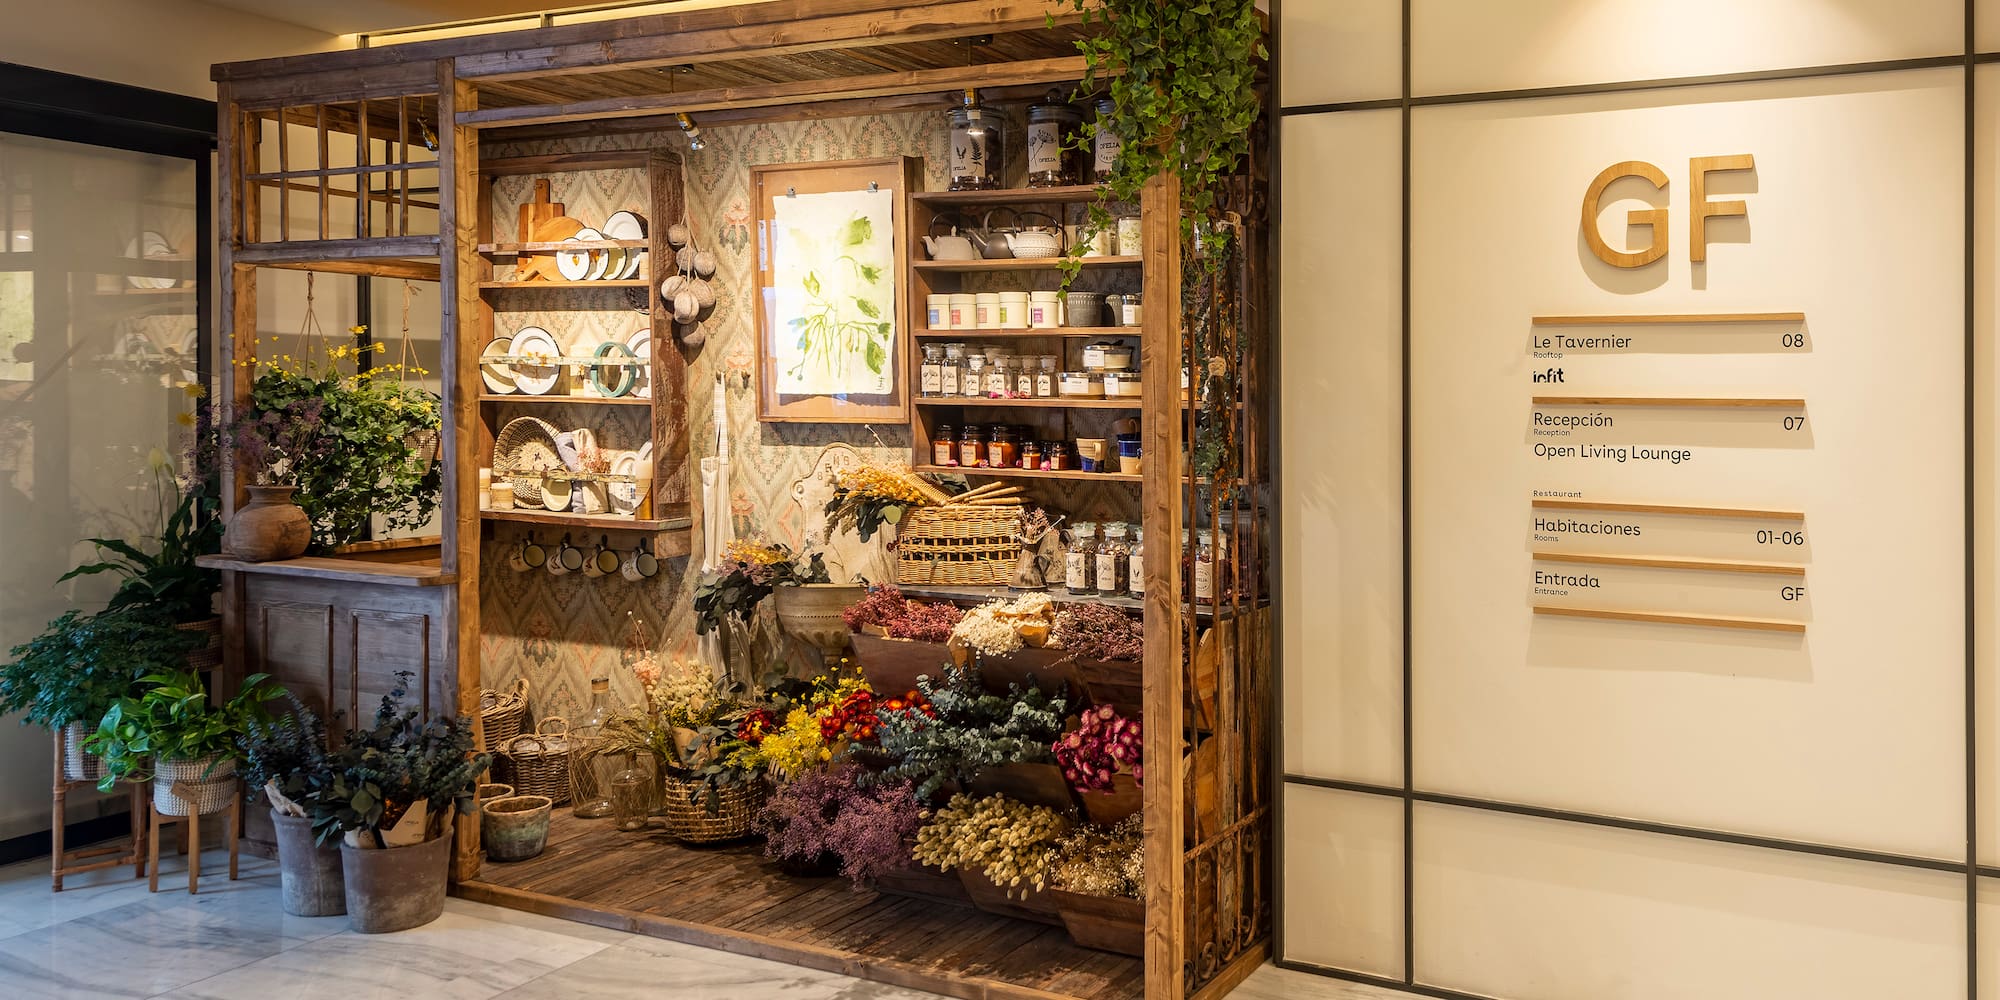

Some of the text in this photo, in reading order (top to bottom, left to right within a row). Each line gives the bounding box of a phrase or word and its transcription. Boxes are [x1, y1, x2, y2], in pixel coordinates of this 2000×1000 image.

[1582, 154, 1753, 268] GF
[1534, 334, 1632, 349] Le Tavernier
[1782, 333, 1804, 348] 08
[1533, 351, 1564, 359] Rooftop
[1534, 412, 1613, 430] Recepción
[1783, 416, 1805, 431] 07
[1533, 428, 1571, 437] Reception
[1534, 443, 1691, 465] Open Living Lounge
[1533, 489, 1582, 499] Restaurant
[1534, 518, 1641, 537] Habitaciones
[1534, 534, 1559, 542] Rooms
[1756, 530, 1804, 546] 01-06
[1534, 571, 1601, 589] Entrada
[1534, 587, 1569, 596] Entrance
[1782, 586, 1805, 601] GF
